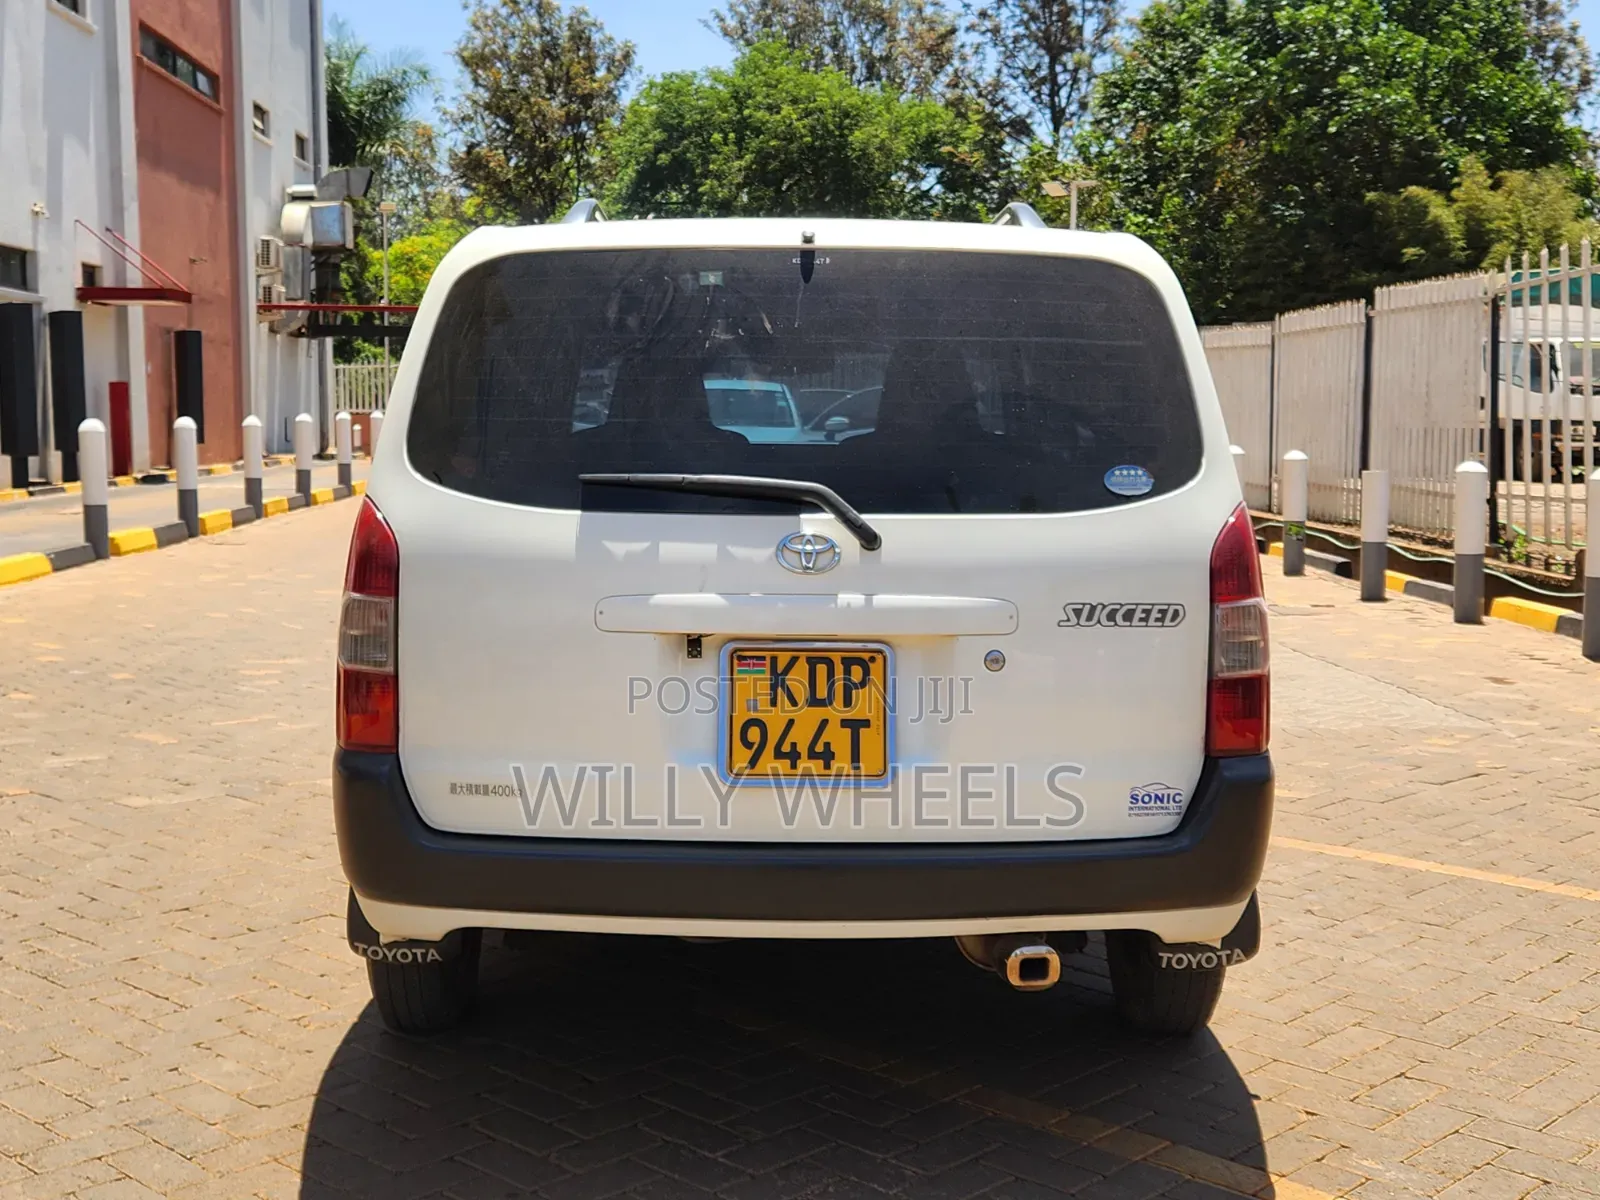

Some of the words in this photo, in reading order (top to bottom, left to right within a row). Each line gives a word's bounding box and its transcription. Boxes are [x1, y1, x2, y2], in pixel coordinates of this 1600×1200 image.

[1057, 603, 1186, 628] SUCCEED
[769, 656, 871, 708] KDP
[739, 718, 871, 770] 944T
[1129, 792, 1183, 805] SONIC
[353, 942, 443, 963] TOYOTA
[1158, 948, 1248, 969] TOYOTA
